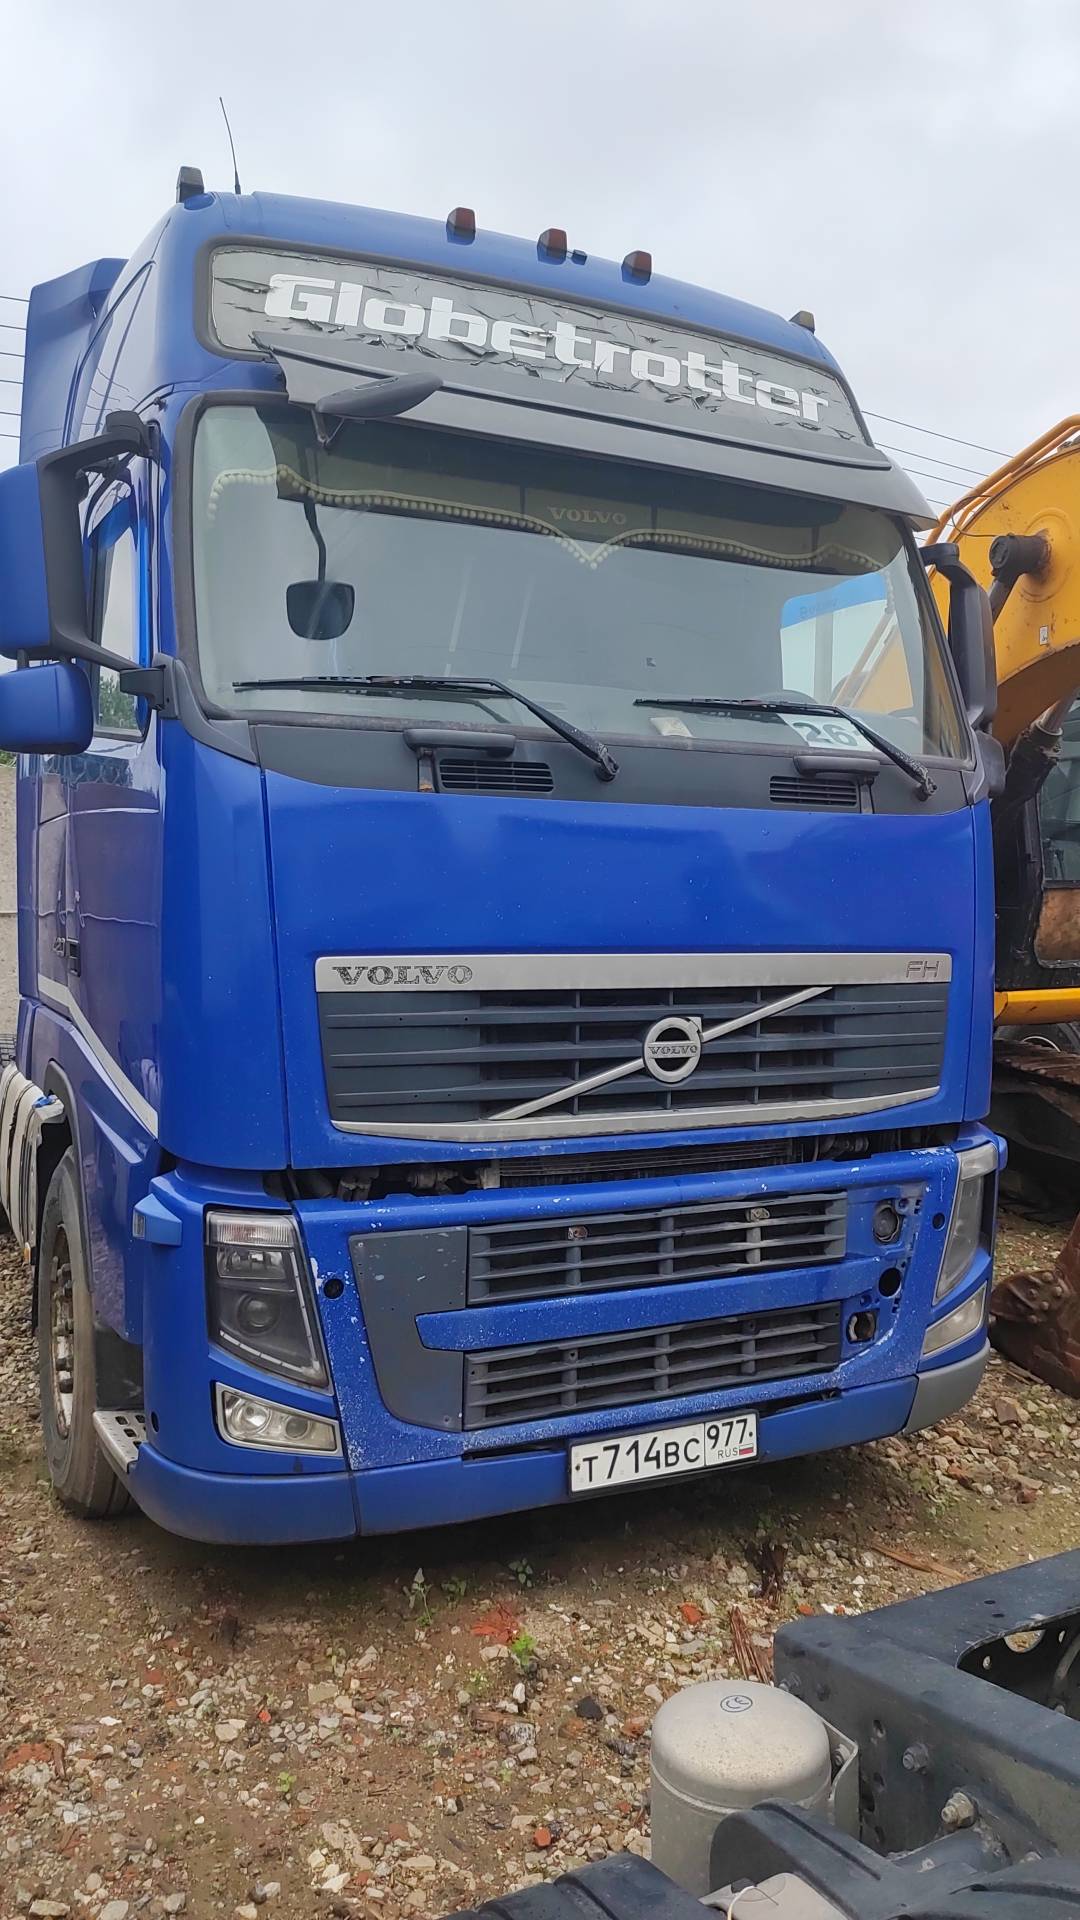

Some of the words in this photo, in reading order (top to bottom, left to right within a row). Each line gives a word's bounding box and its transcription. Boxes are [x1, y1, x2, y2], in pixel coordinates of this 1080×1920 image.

[263, 272, 829, 422] Globetrotter
[547, 506, 627, 525] VOLVO
[793, 722, 861, 746] 26
[332, 965, 473, 985] VOLVO
[905, 960, 940, 978] FH
[647, 1044, 698, 1055] VOLVO
[706, 1418, 749, 1450] 977
[717, 1447, 738, 1460] RUS
